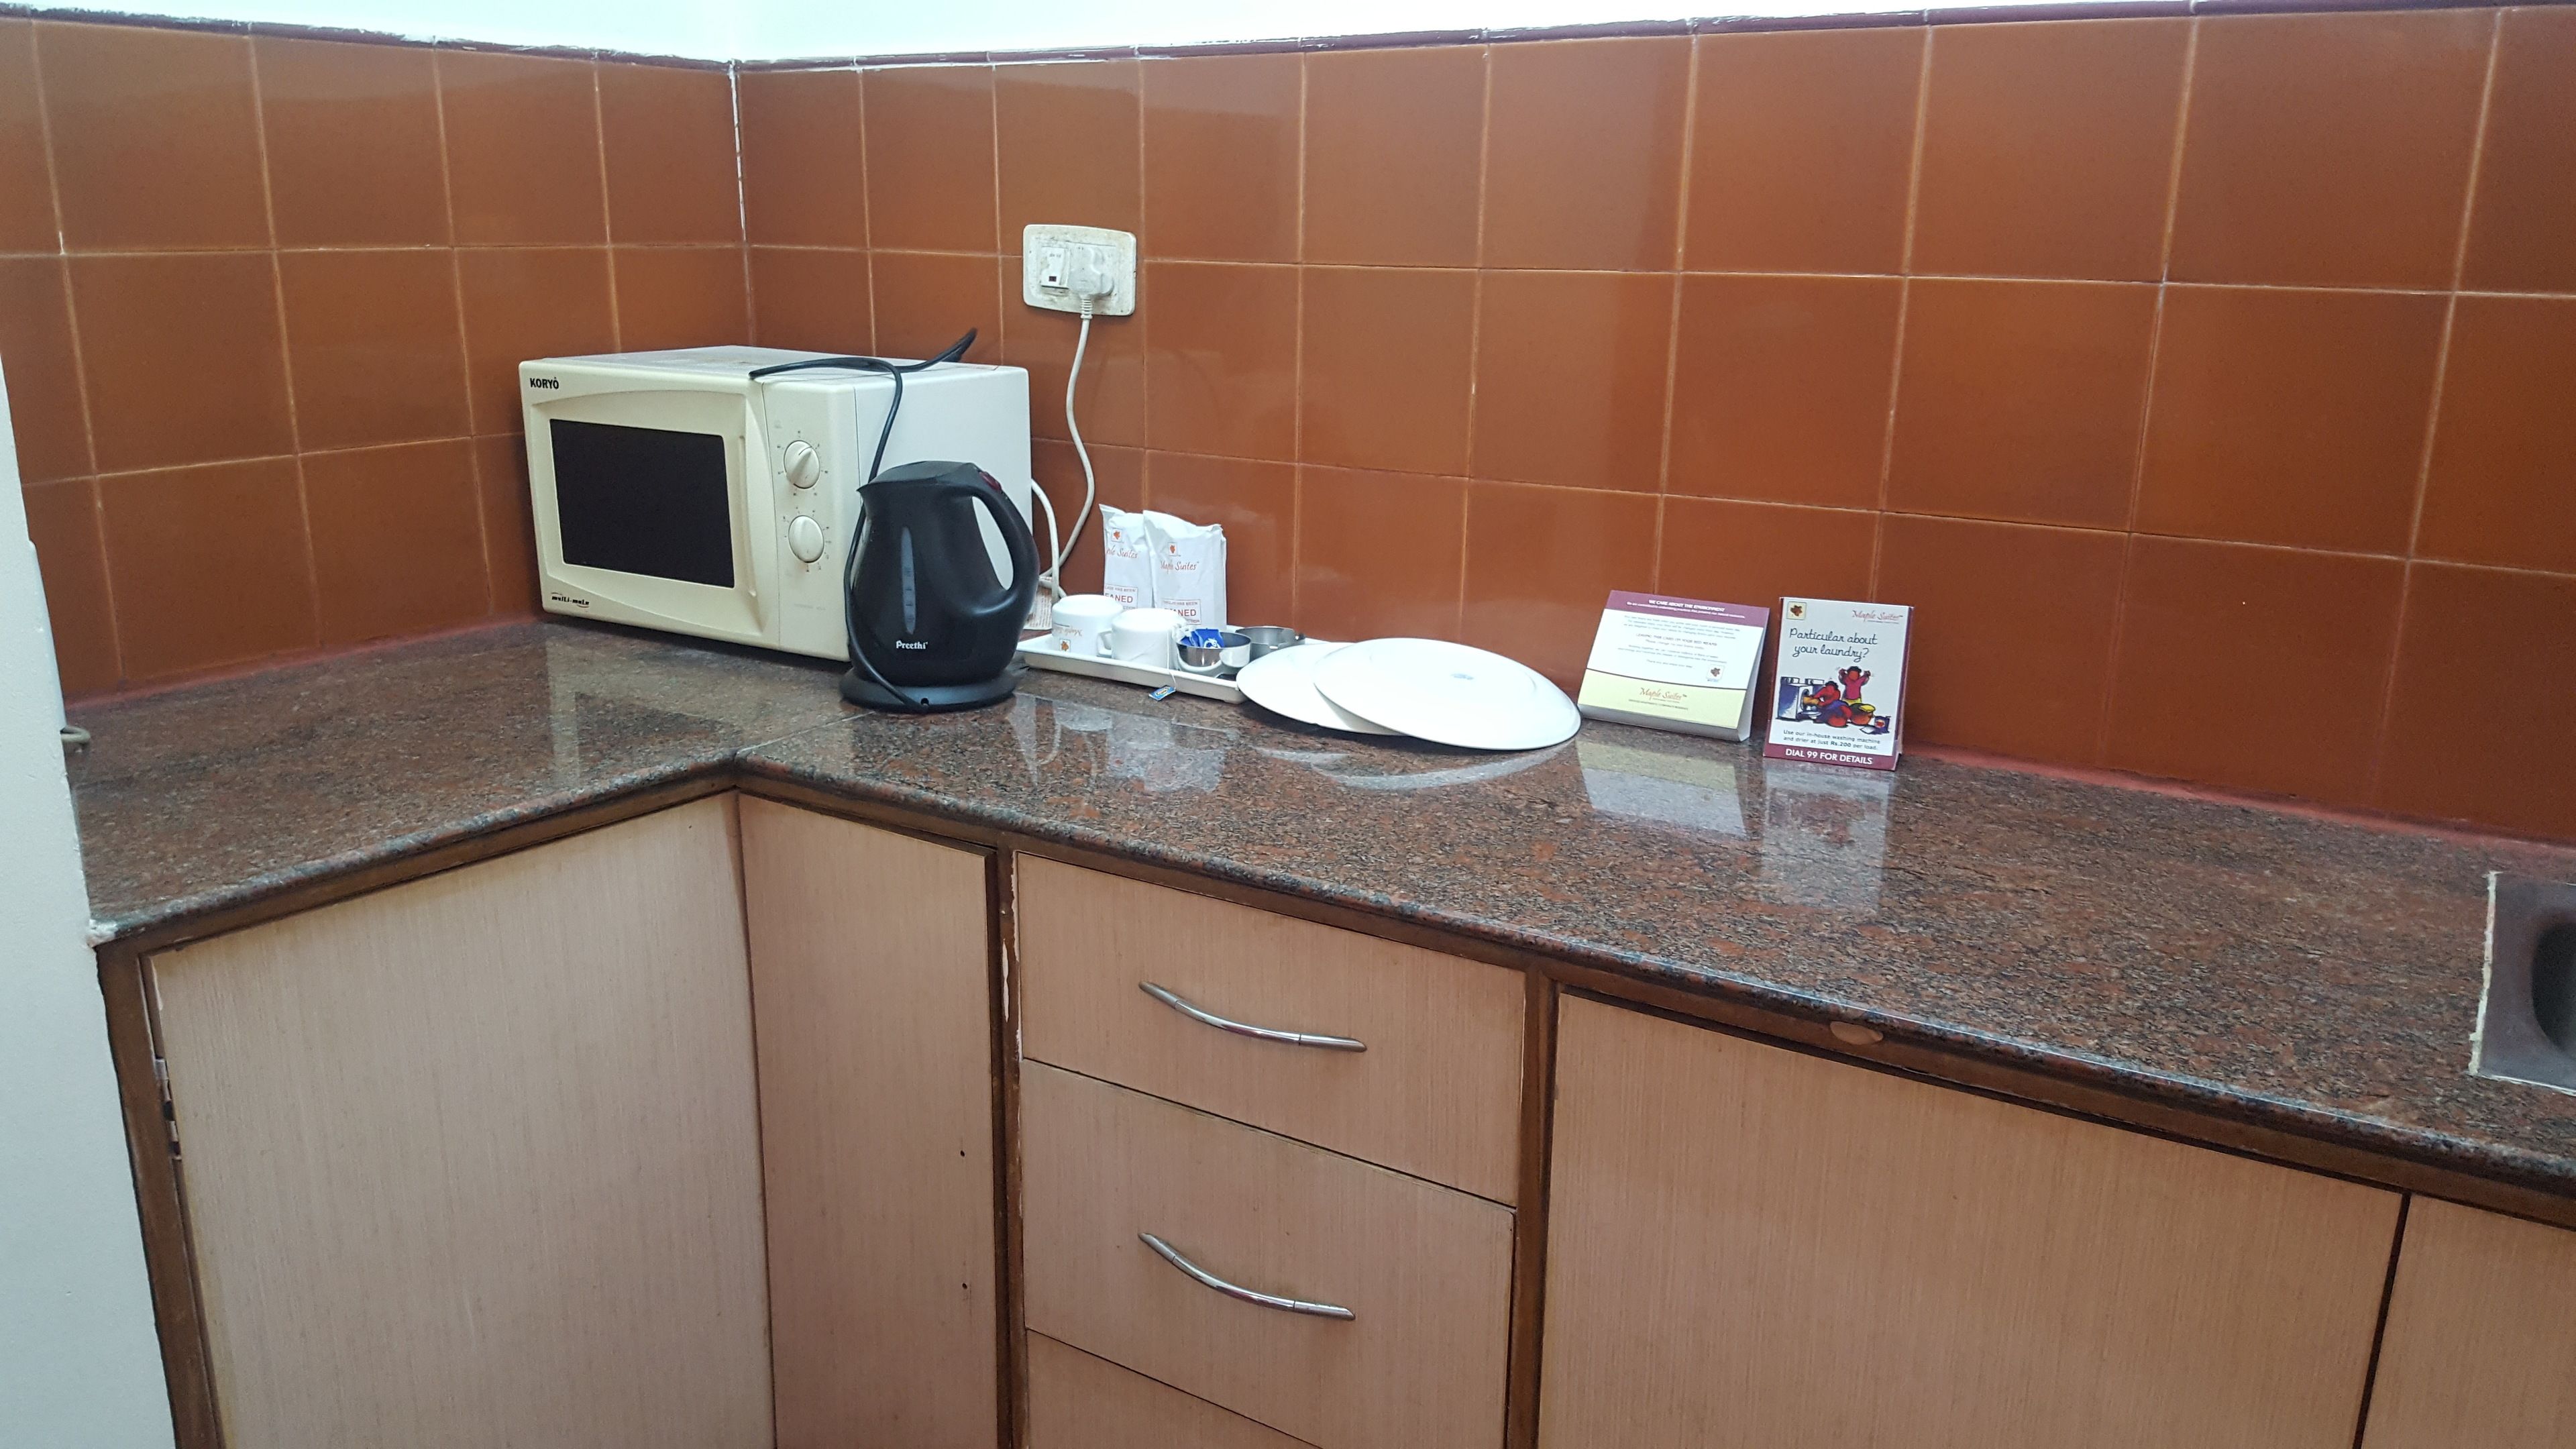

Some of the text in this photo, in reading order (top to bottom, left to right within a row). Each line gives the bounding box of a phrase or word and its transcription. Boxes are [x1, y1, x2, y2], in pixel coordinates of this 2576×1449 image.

[1117, 547, 1138, 559] Suites
[1175, 561, 1197, 571] Suites
[1789, 627, 1878, 645] Particular about
[896, 640, 926, 650] Preethi
[1792, 644, 1870, 663] your laundry?
[1640, 687, 1662, 700] Maple
[1662, 690, 1682, 700] Suites
[1785, 748, 1874, 765] DIAL 99 FOR DETAILS
